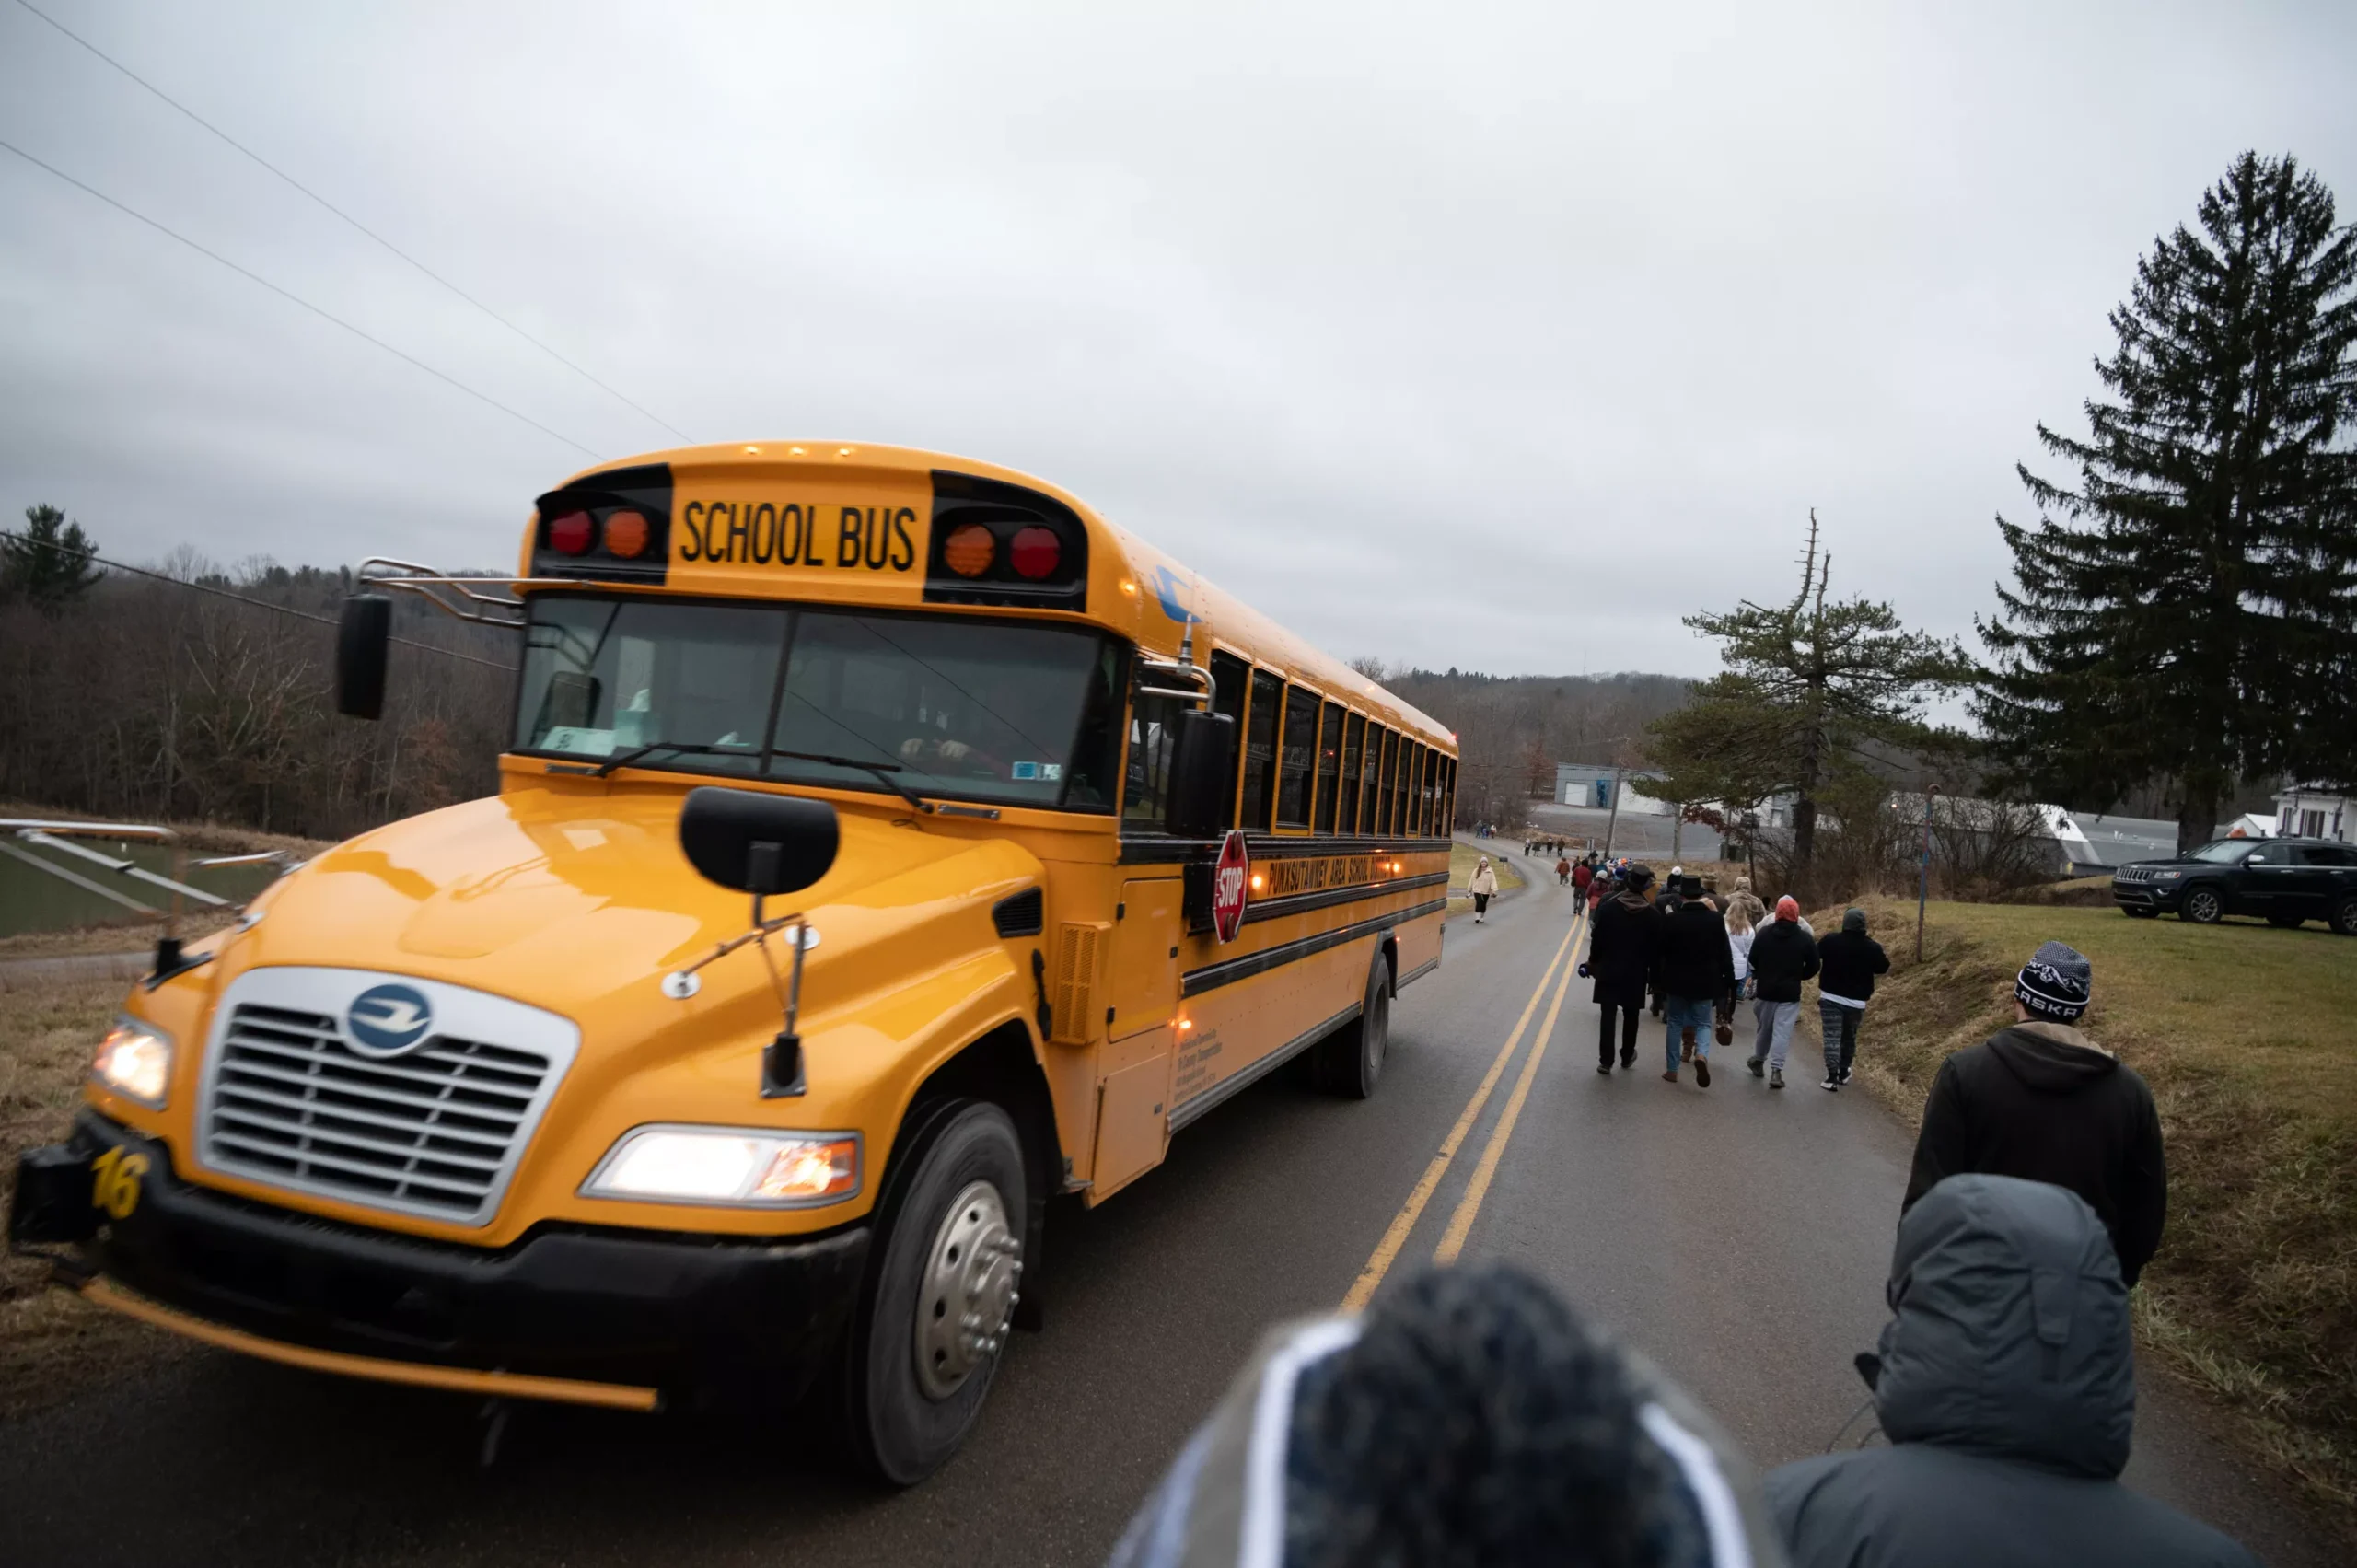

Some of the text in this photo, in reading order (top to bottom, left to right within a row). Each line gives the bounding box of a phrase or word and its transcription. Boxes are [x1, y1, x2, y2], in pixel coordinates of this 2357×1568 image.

[679, 500, 918, 572] SCHOOL BUS
[1218, 866, 1244, 908] STOP
[1329, 857, 1346, 886] AREA
[90, 1144, 151, 1220] 16
